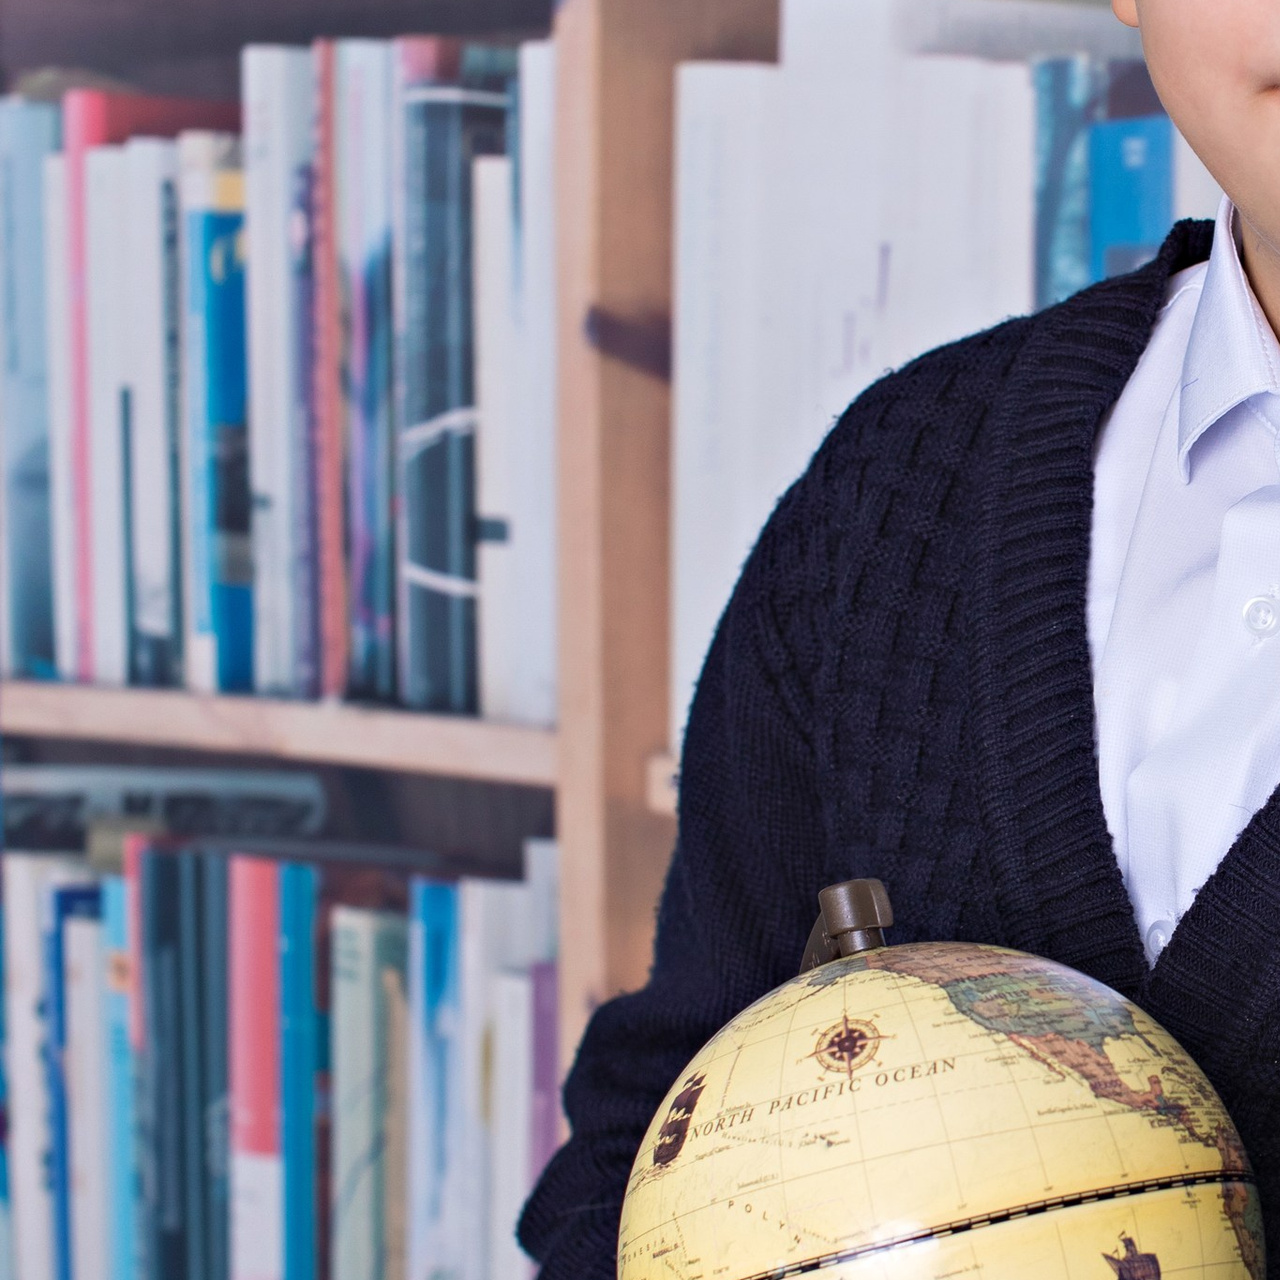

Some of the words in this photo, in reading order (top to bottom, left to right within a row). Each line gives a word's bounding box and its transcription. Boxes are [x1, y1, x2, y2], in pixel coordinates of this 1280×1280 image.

[689, 1108, 755, 1142] NORTH
[768, 1079, 862, 1115] PACIFIC
[875, 1057, 956, 1087] OCEAN
